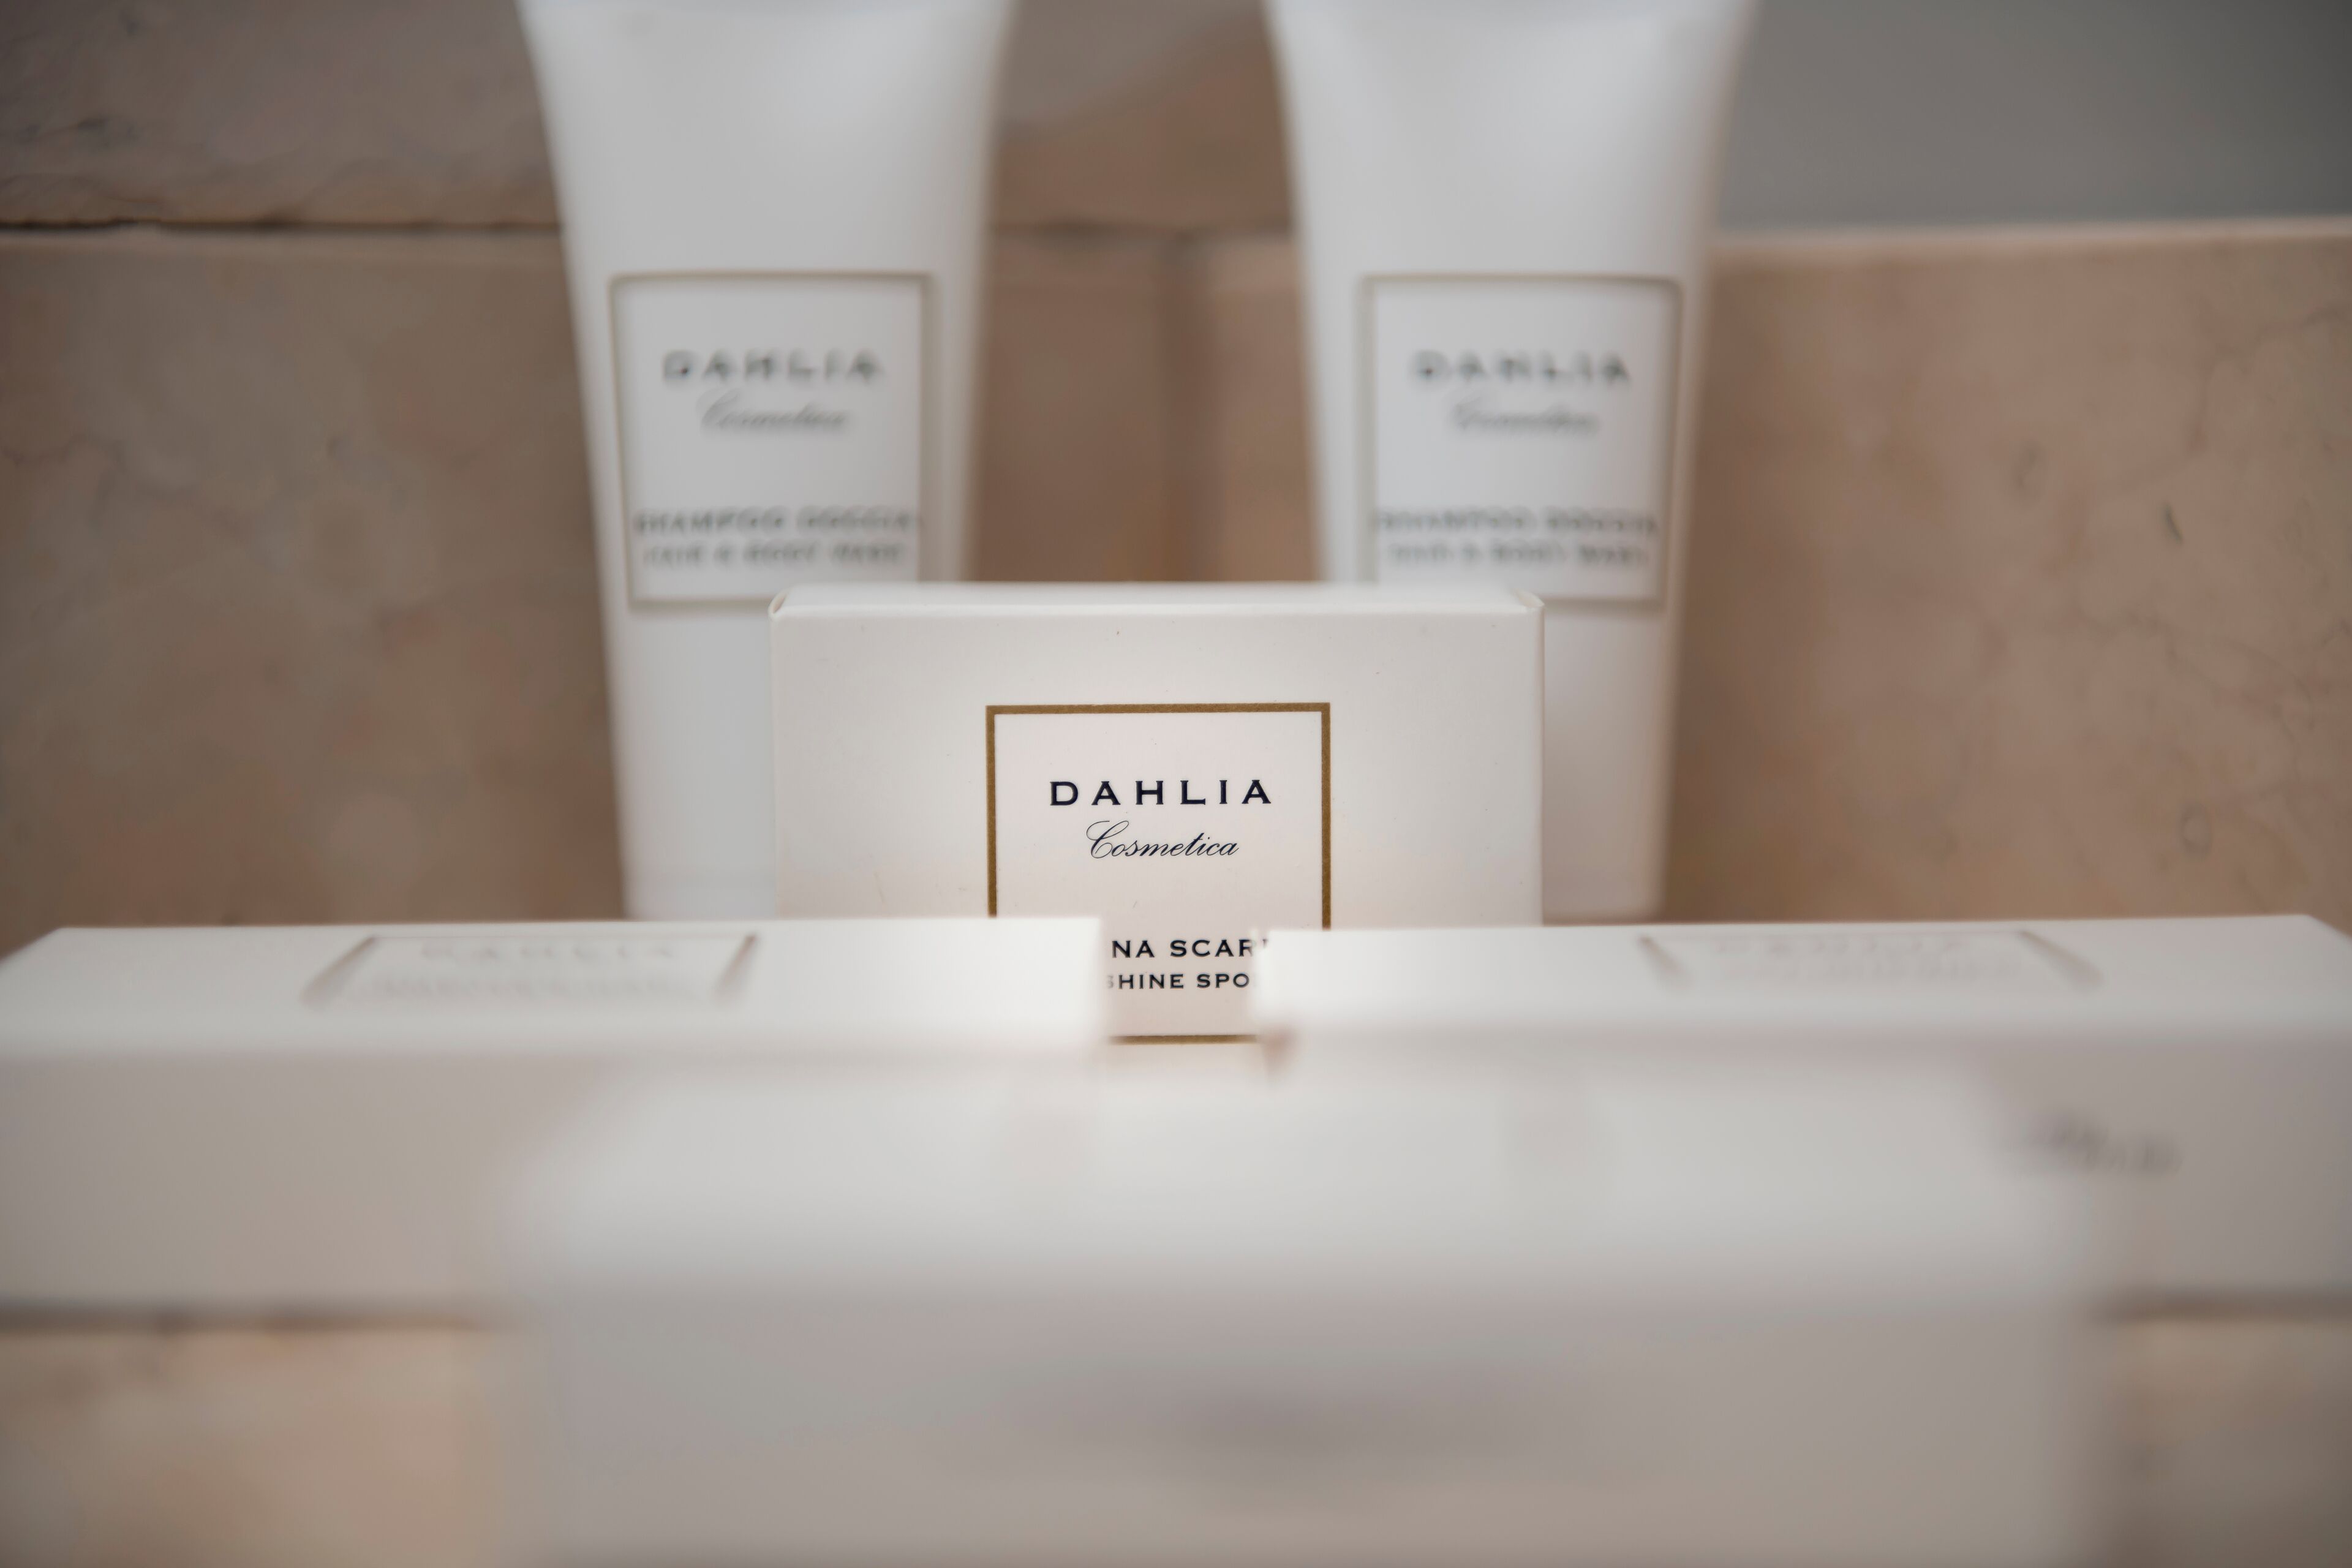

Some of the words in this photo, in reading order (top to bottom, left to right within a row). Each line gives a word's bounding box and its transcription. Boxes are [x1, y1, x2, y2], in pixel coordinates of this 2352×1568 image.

[663, 349, 883, 384] DAHLIA
[1412, 349, 1629, 384] DAHLIA
[1050, 779, 1272, 806] DAHLIA
[1085, 820, 1240, 859] Cosmetica
[1111, 940, 1155, 959] NA
[1170, 938, 1268, 958] SCAR
[1196, 973, 1250, 989] SPO
